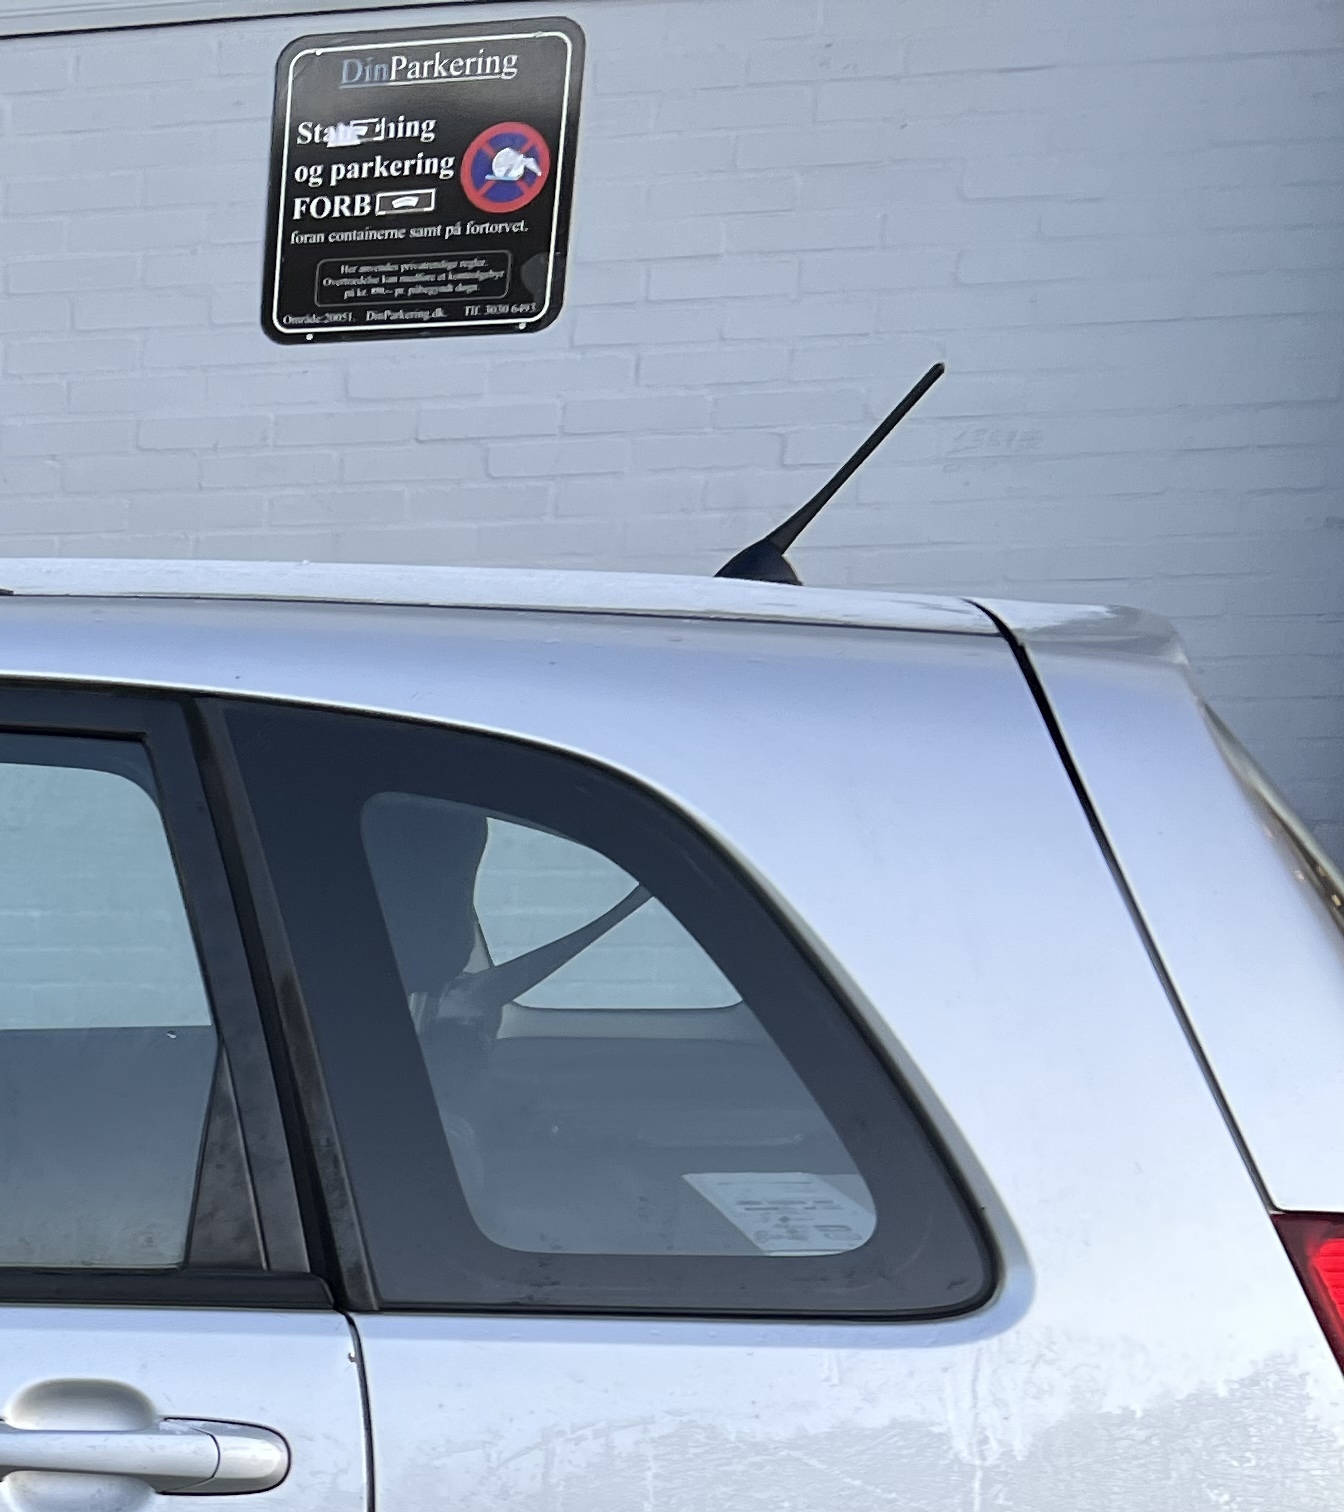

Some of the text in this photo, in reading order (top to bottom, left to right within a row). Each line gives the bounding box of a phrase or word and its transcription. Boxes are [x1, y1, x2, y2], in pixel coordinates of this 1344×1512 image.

[341, 48, 518, 83] DinParkering
[294, 152, 456, 188] og parkering
[290, 230, 325, 245] foran
[328, 226, 406, 243] containerne
[409, 224, 442, 238] samt
[444, 221, 462, 240] på
